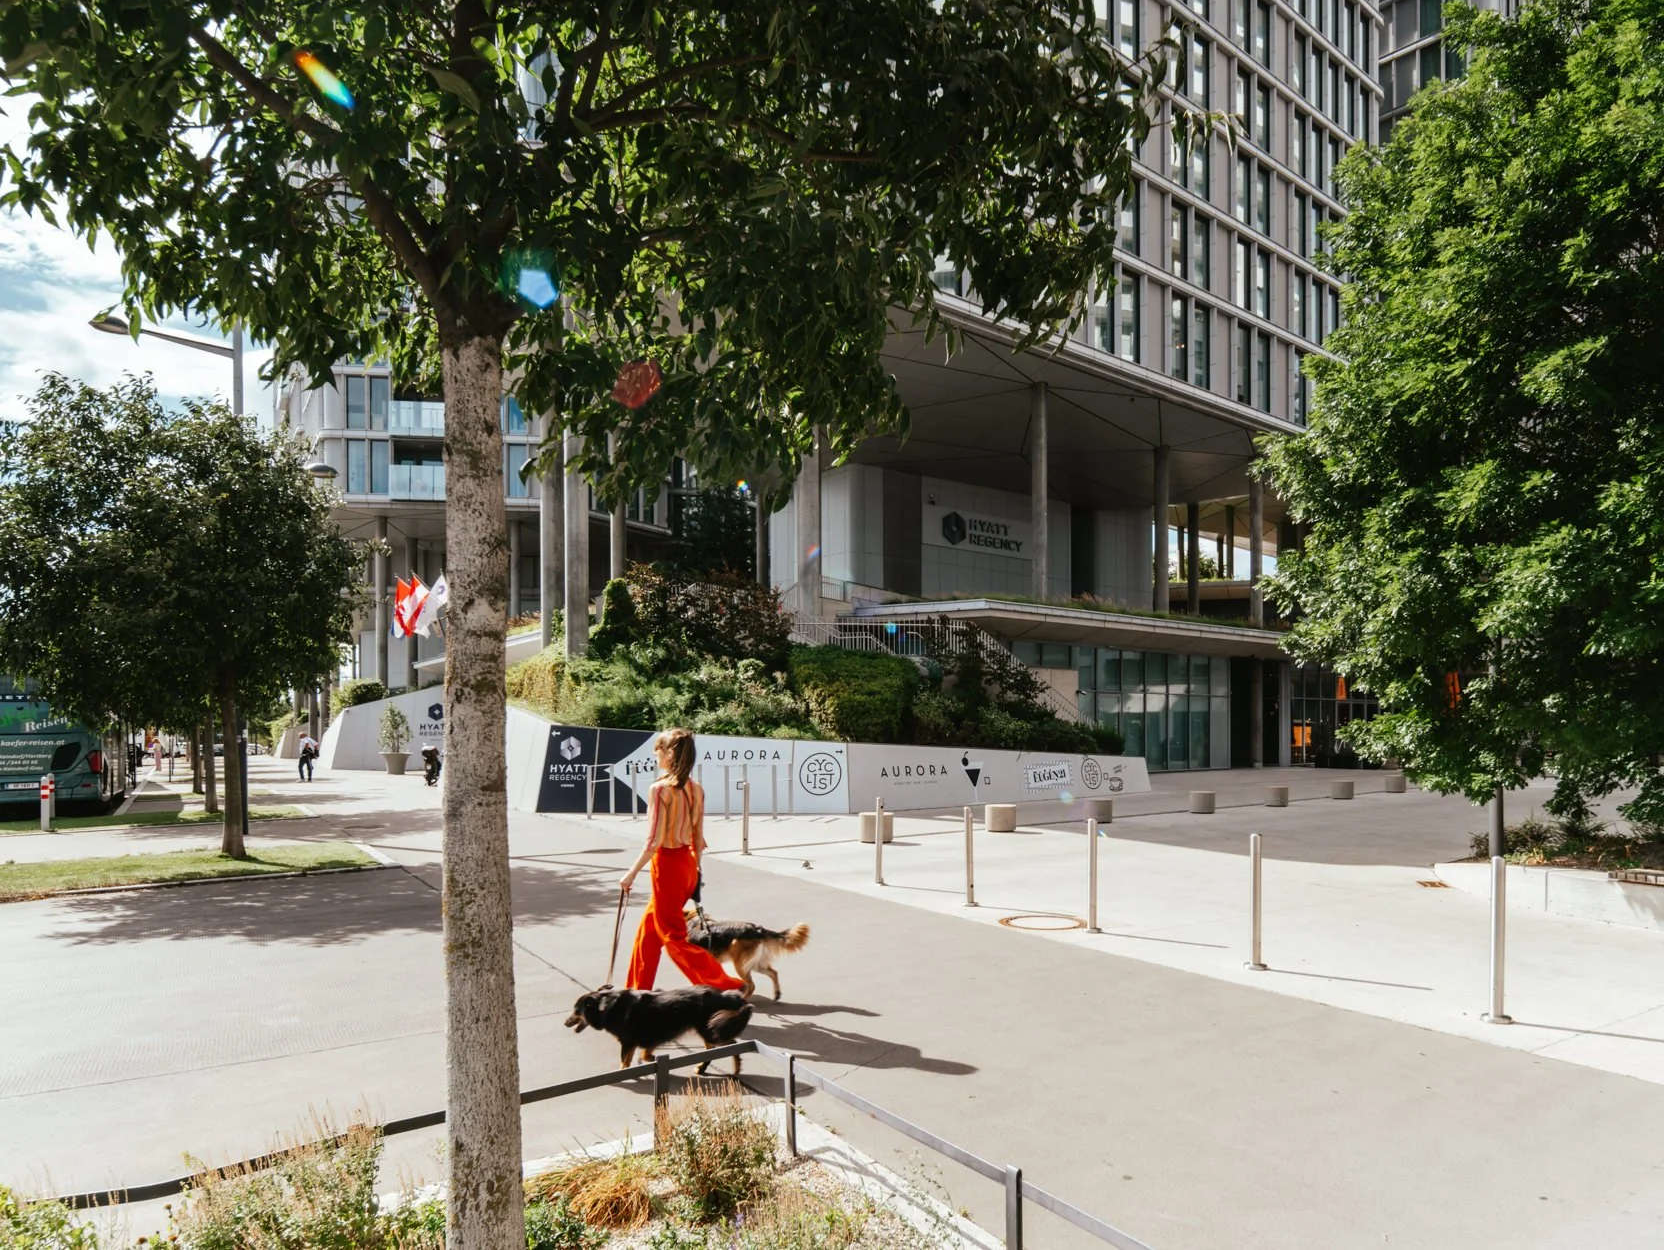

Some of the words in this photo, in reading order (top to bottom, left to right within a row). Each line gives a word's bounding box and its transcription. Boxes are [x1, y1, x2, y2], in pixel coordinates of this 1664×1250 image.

[968, 518, 1009, 537] HYATT
[968, 533, 1023, 552] REGENCY
[24, 717, 68, 733] Reisen
[419, 723, 445, 731] HYAT
[704, 750, 781, 761] AURORA
[549, 764, 588, 773] HYATT
[881, 764, 948, 778] AURORA
[548, 774, 588, 782] REGENCY
